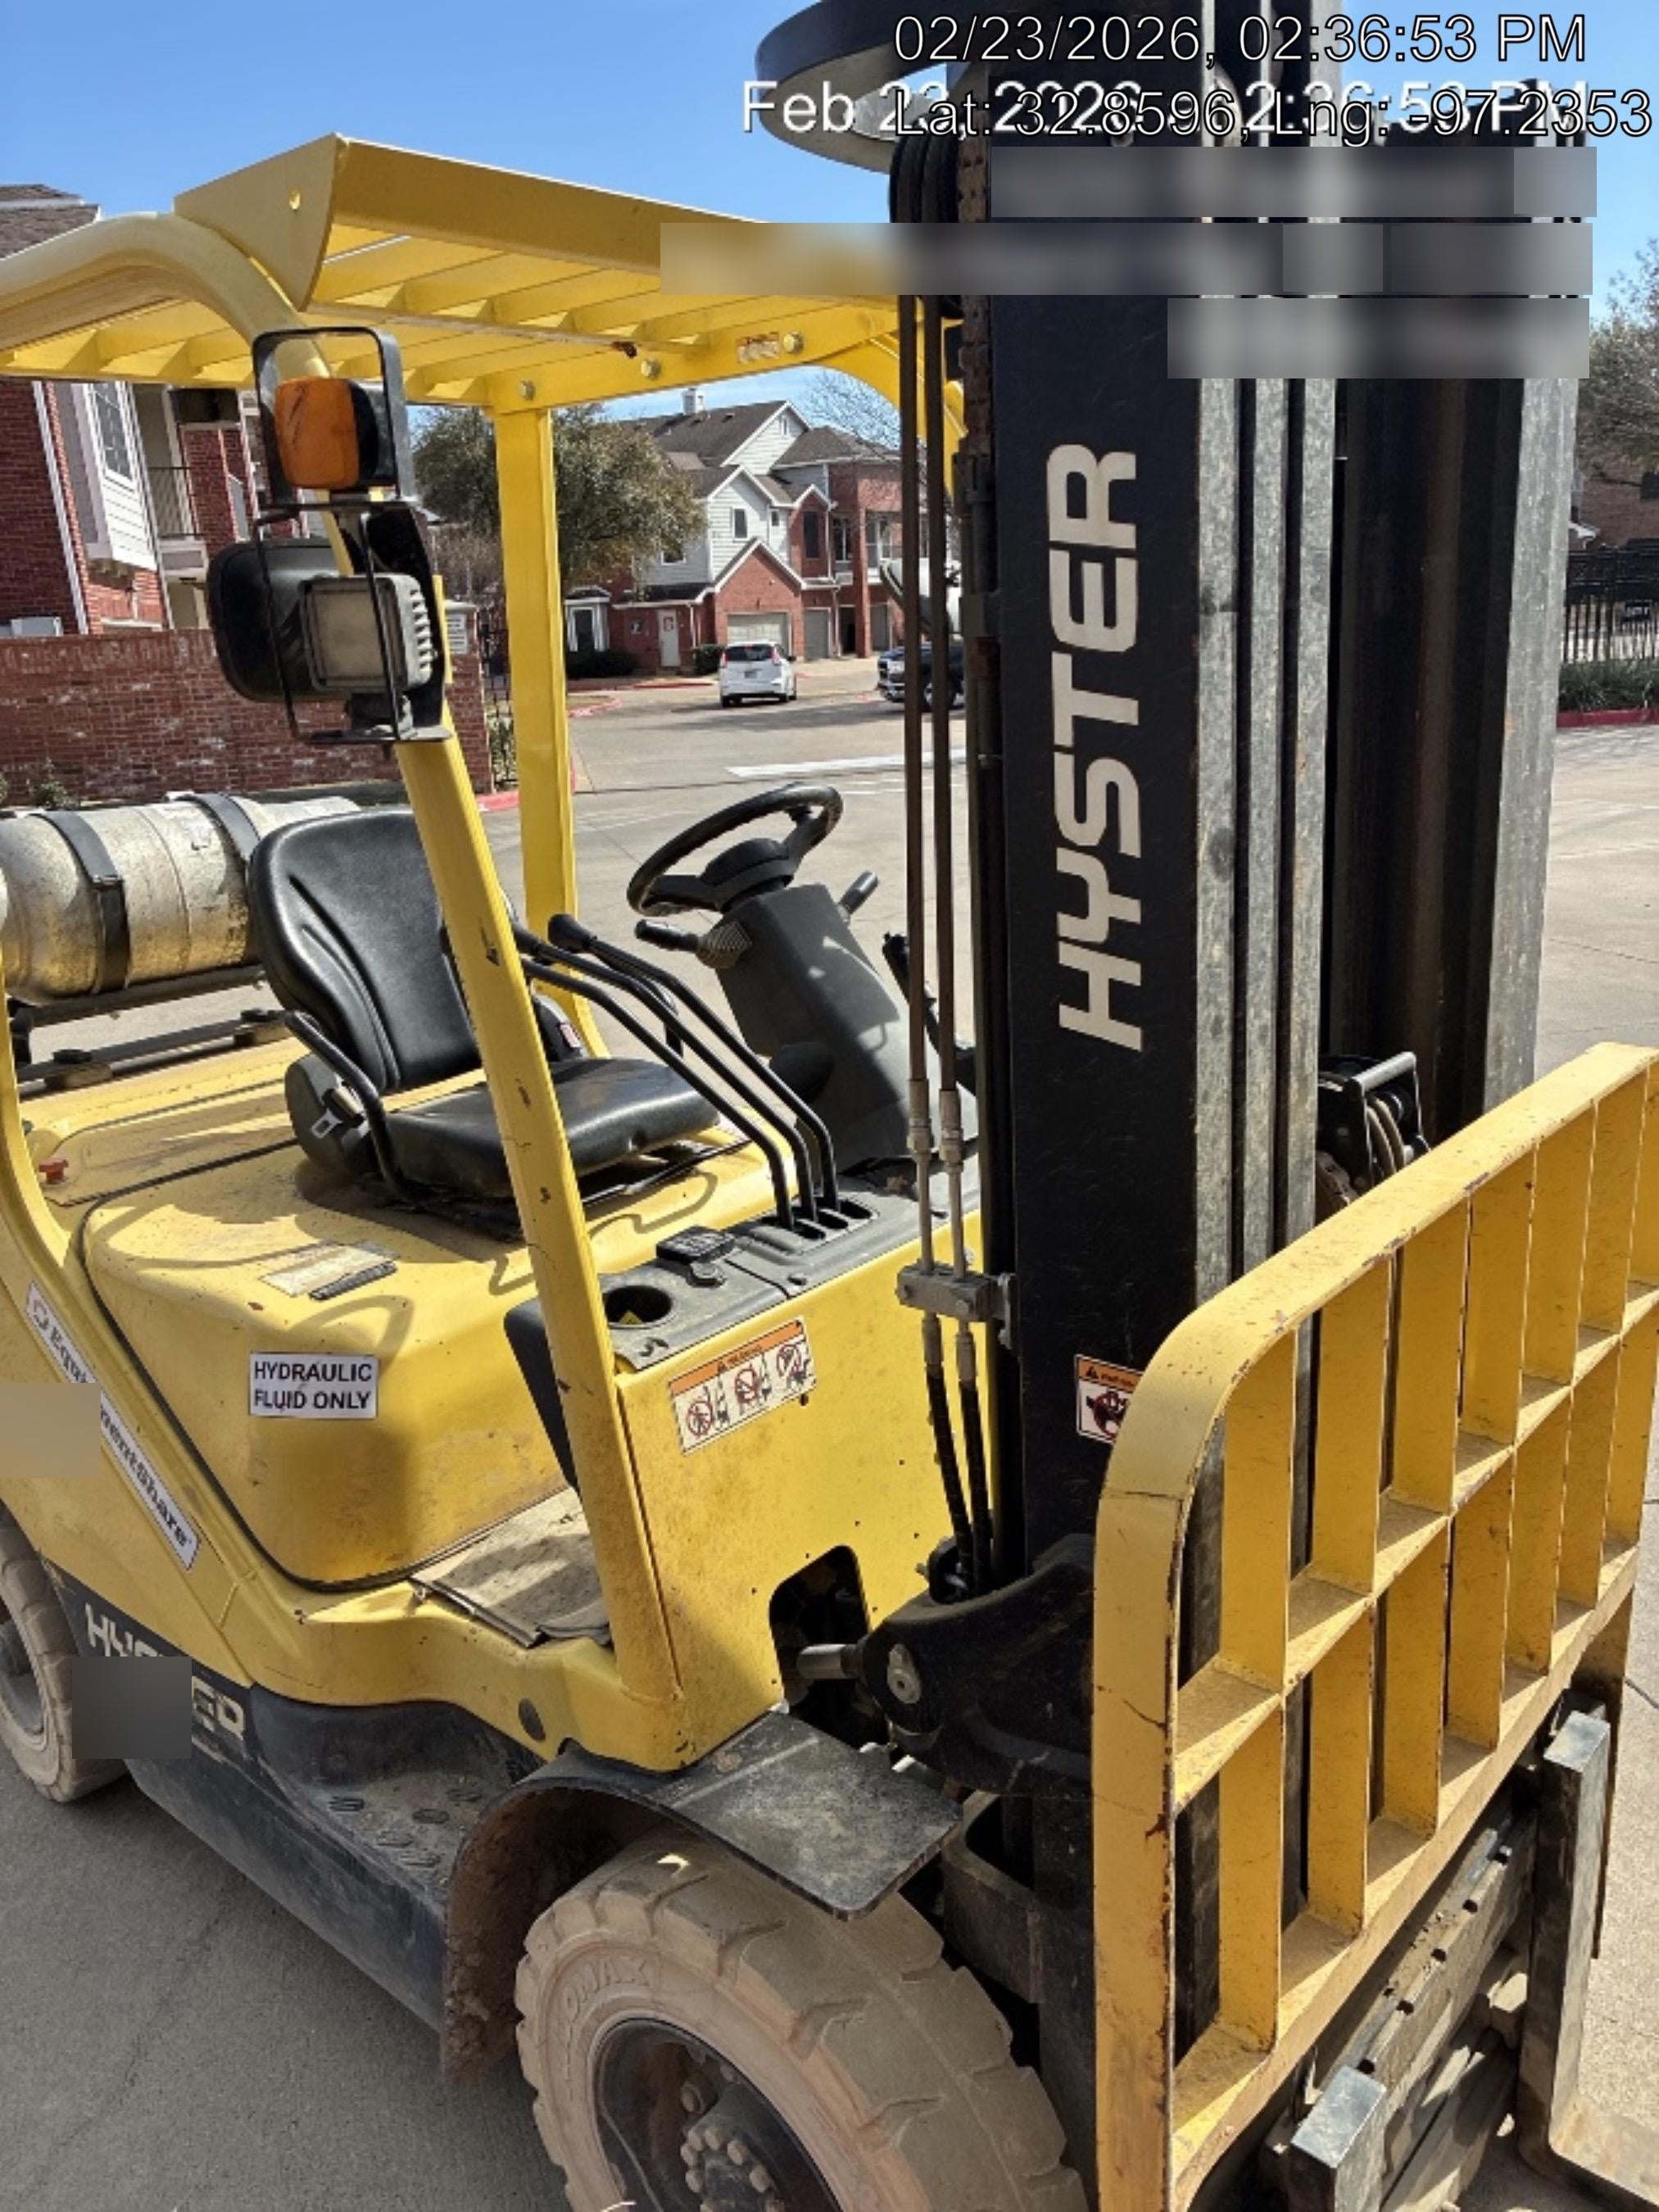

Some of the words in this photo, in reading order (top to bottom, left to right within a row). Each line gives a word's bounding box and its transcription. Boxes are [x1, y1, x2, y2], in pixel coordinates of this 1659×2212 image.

[1046, 443, 1143, 1052] HYSTER
[254, 1361, 373, 1383] HYDRAULIC
[254, 1389, 307, 1410] FLUID
[313, 1391, 371, 1410] ONLY
